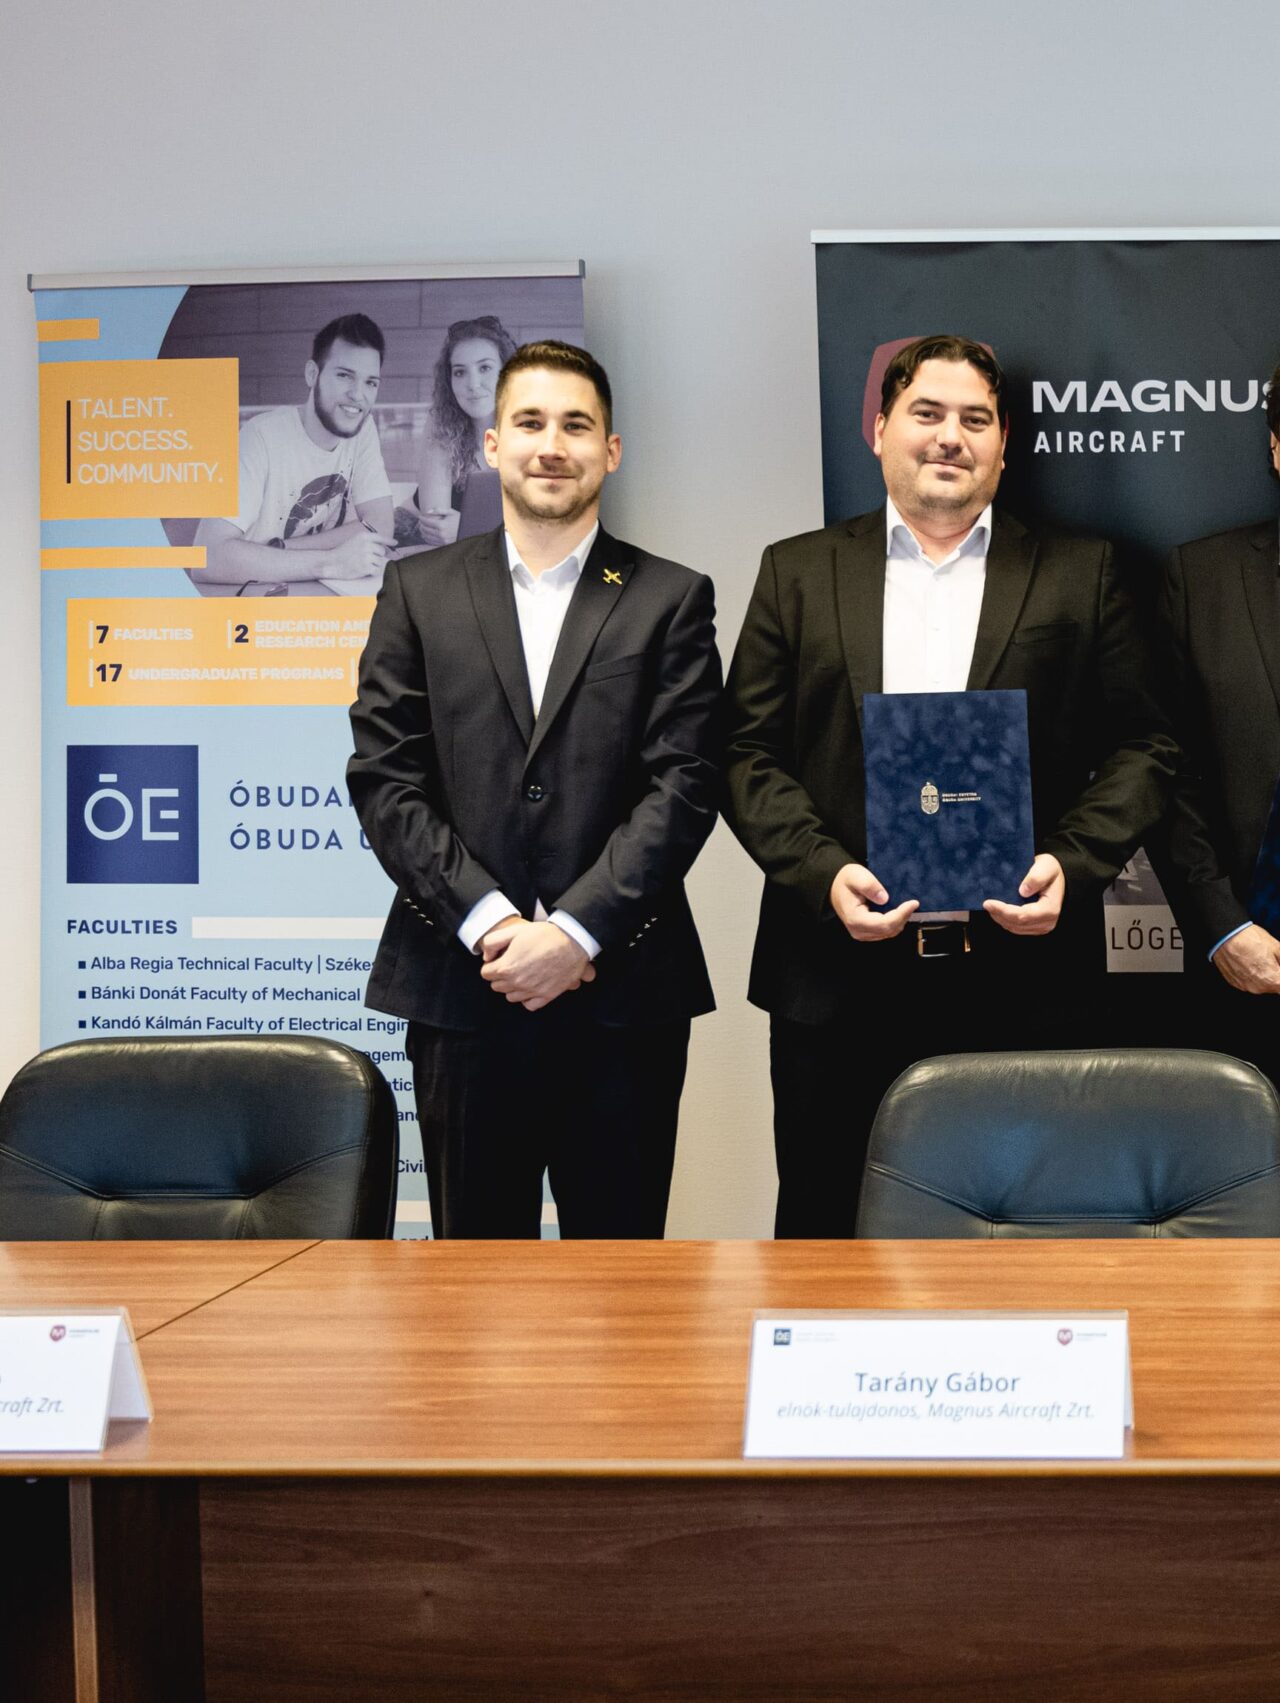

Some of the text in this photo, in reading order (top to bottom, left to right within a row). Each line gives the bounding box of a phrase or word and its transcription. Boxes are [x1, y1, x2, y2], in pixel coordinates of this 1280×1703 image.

[79, 397, 173, 419] TALENT.
[78, 429, 193, 452] SUCCESS.
[1034, 430, 1186, 454] AIRCRAFT
[78, 461, 223, 485] COMMUNITY.
[96, 625, 194, 644] 7 FACULTIES
[234, 624, 249, 643] 2
[255, 619, 339, 633] EDUCATION
[255, 635, 368, 648] RESEARCH CEN
[96, 663, 345, 683] 17 UNDERGRADUATE PROGRAMS
[229, 822, 343, 850] ÓBUDA
[67, 919, 178, 936] FACULTIES
[1111, 920, 1183, 950] LŐGE
[91, 956, 374, 976] Alba Regia Technical Faculty Széke
[91, 985, 361, 1005] Bánki Donát Faculty of Mechanical
[91, 1015, 141, 1031] Kandó
[145, 1015, 202, 1031] Kálmán
[206, 1016, 264, 1035] Faculty
[268, 1016, 286, 1032] of
[289, 1017, 362, 1032] Electrical
[855, 1371, 1021, 1398] Tarány Gábor
[37, 1397, 64, 1413] Zrt.
[928, 1402, 994, 1422] Magnus
[999, 1402, 1062, 1422] Aircraft
[1067, 1402, 1095, 1418] Zrt.
